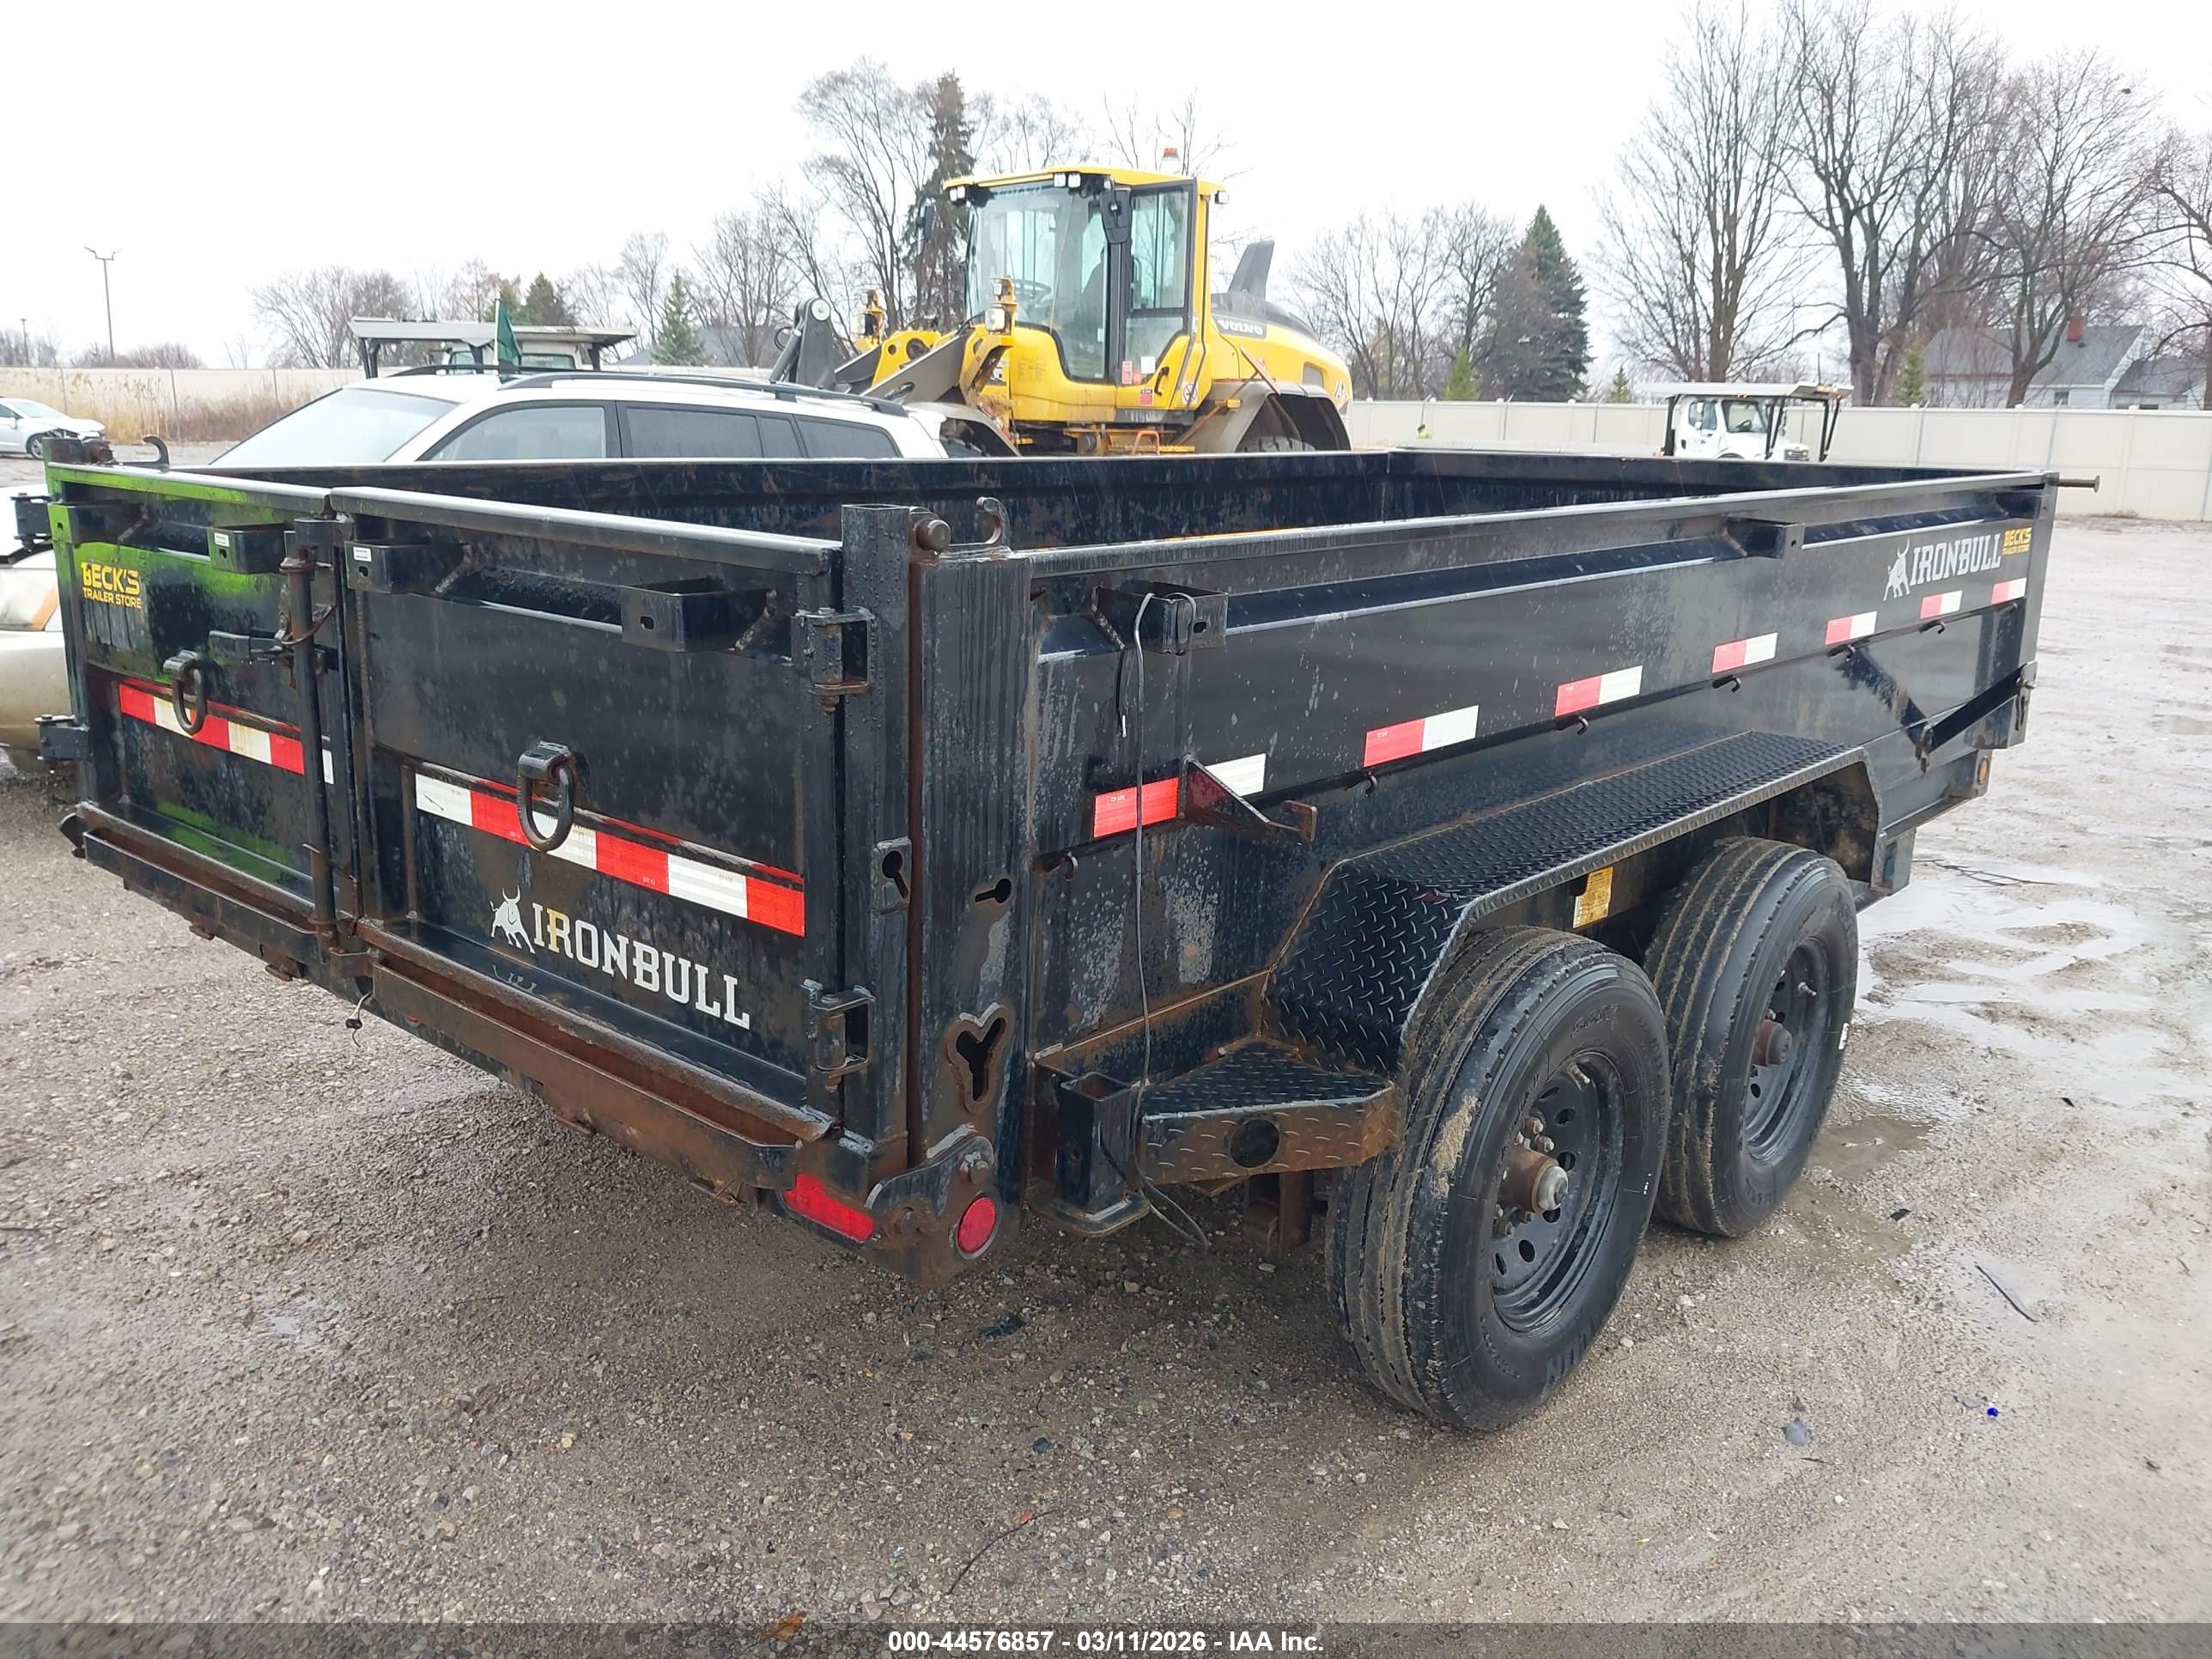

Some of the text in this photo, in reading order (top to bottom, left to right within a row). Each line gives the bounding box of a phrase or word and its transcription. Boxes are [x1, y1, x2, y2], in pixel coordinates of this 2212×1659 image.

[1217, 319, 1264, 336] VOLVO
[1910, 532, 2002, 586] IRONBULL
[81, 562, 140, 595] BECK'S
[82, 586, 142, 609] TRAILER STORE
[531, 902, 750, 1030] IRONBULL
